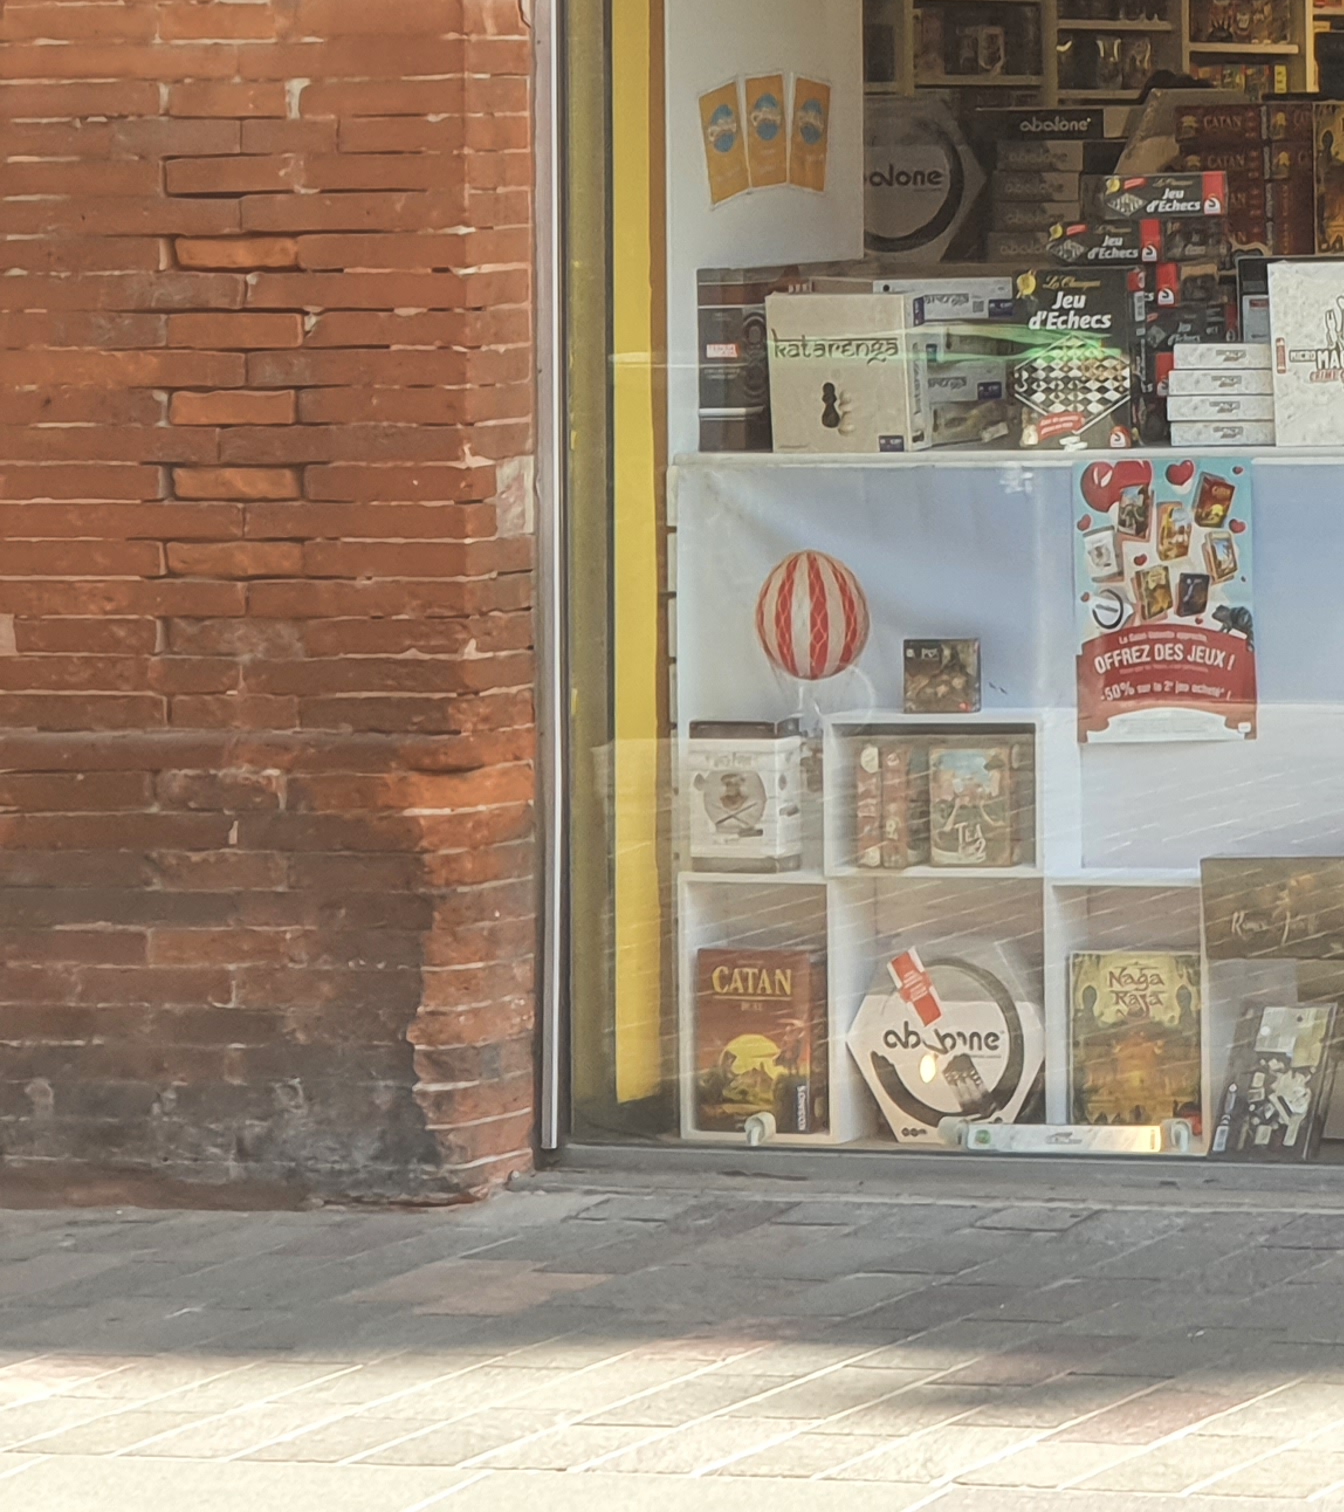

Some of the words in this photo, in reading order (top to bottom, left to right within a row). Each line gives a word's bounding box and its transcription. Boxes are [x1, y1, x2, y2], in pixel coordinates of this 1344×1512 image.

[1204, 116, 1242, 128] CATAN
[1208, 155, 1246, 168] CATAN
[1162, 188, 1184, 200] Jeu
[1102, 236, 1123, 247] Jeu
[1052, 291, 1086, 309] Jeu
[771, 328, 899, 365] katarenga
[1094, 644, 1150, 674] OFFREZ
[1154, 643, 1184, 661] DES
[1187, 645, 1225, 668] JEUX
[1100, 680, 1135, 702] -50%
[954, 823, 983, 842] TEA
[712, 966, 792, 996] CATAN
[1108, 967, 1165, 991] Naga
